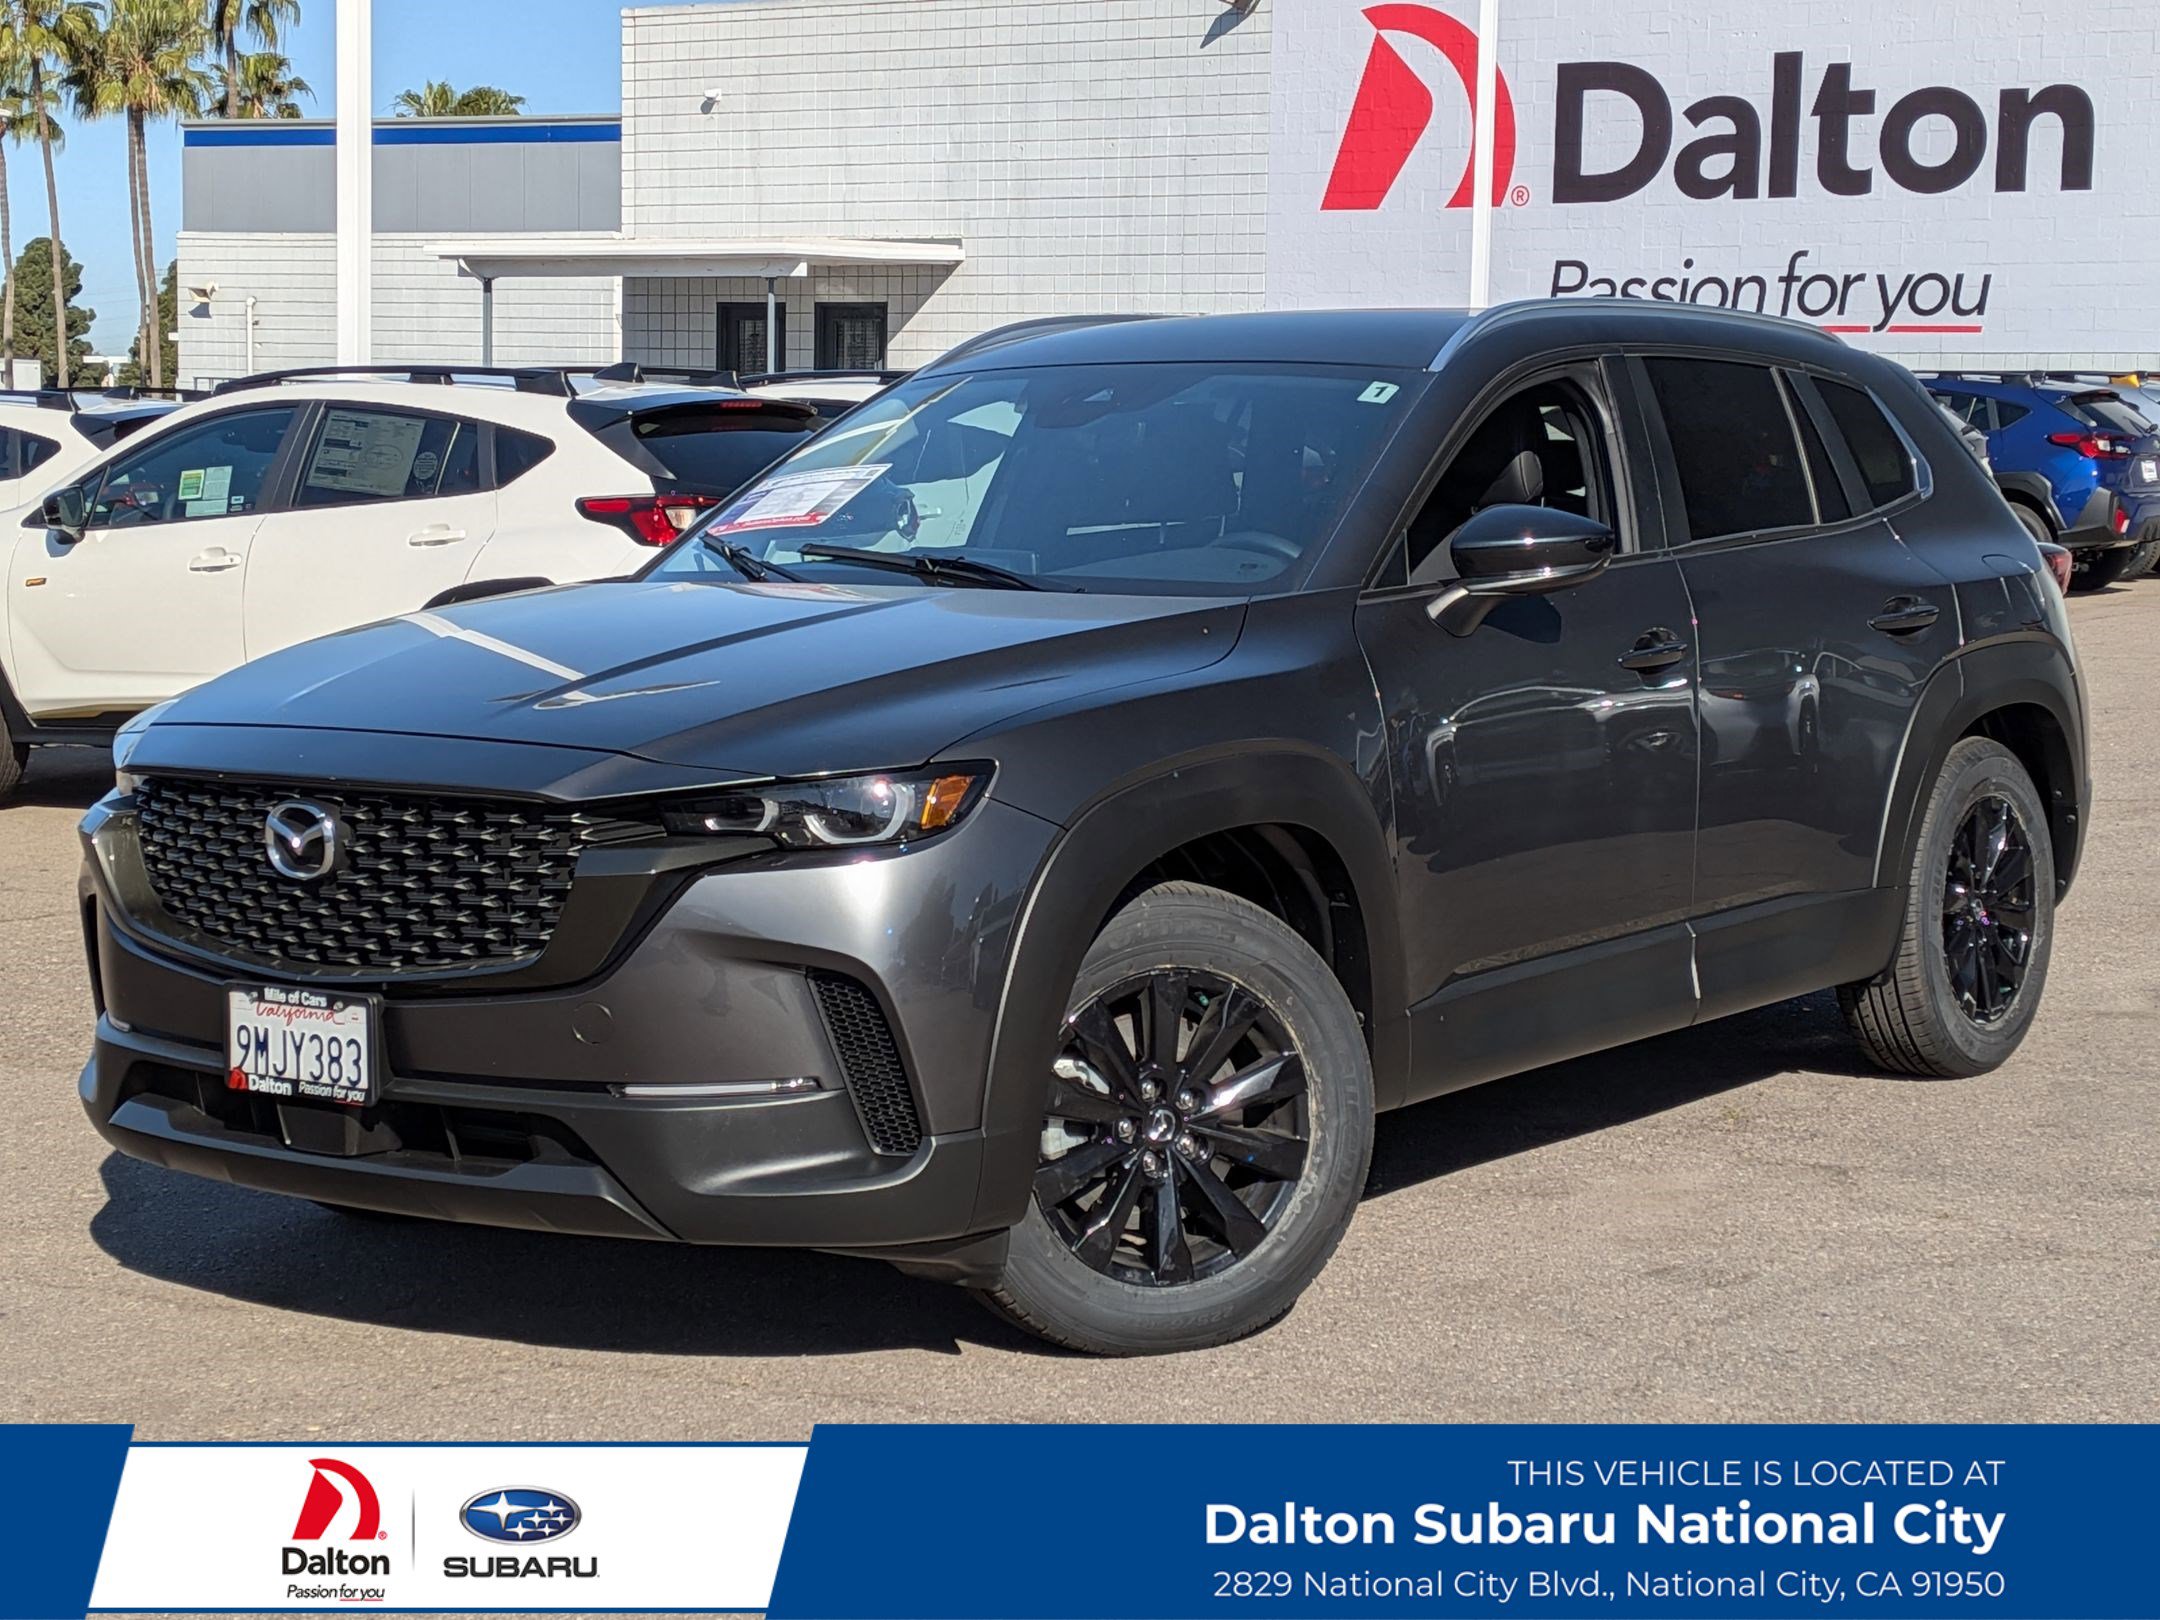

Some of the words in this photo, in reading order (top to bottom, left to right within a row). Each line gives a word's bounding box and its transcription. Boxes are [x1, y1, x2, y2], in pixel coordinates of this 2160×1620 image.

[1552, 51, 2095, 204] Dalton
[1777, 249, 1867, 318] for
[1872, 272, 1992, 333] you
[1375, 384, 1389, 398] 1
[264, 986, 287, 1003] Mile
[288, 990, 300, 1004] of
[301, 991, 327, 1008] Cars
[236, 1024, 362, 1088] 9MJY383
[248, 1074, 292, 1096] Dalton
[299, 1081, 332, 1097] Passion
[333, 1086, 347, 1099] for
[347, 1089, 366, 1102] you
